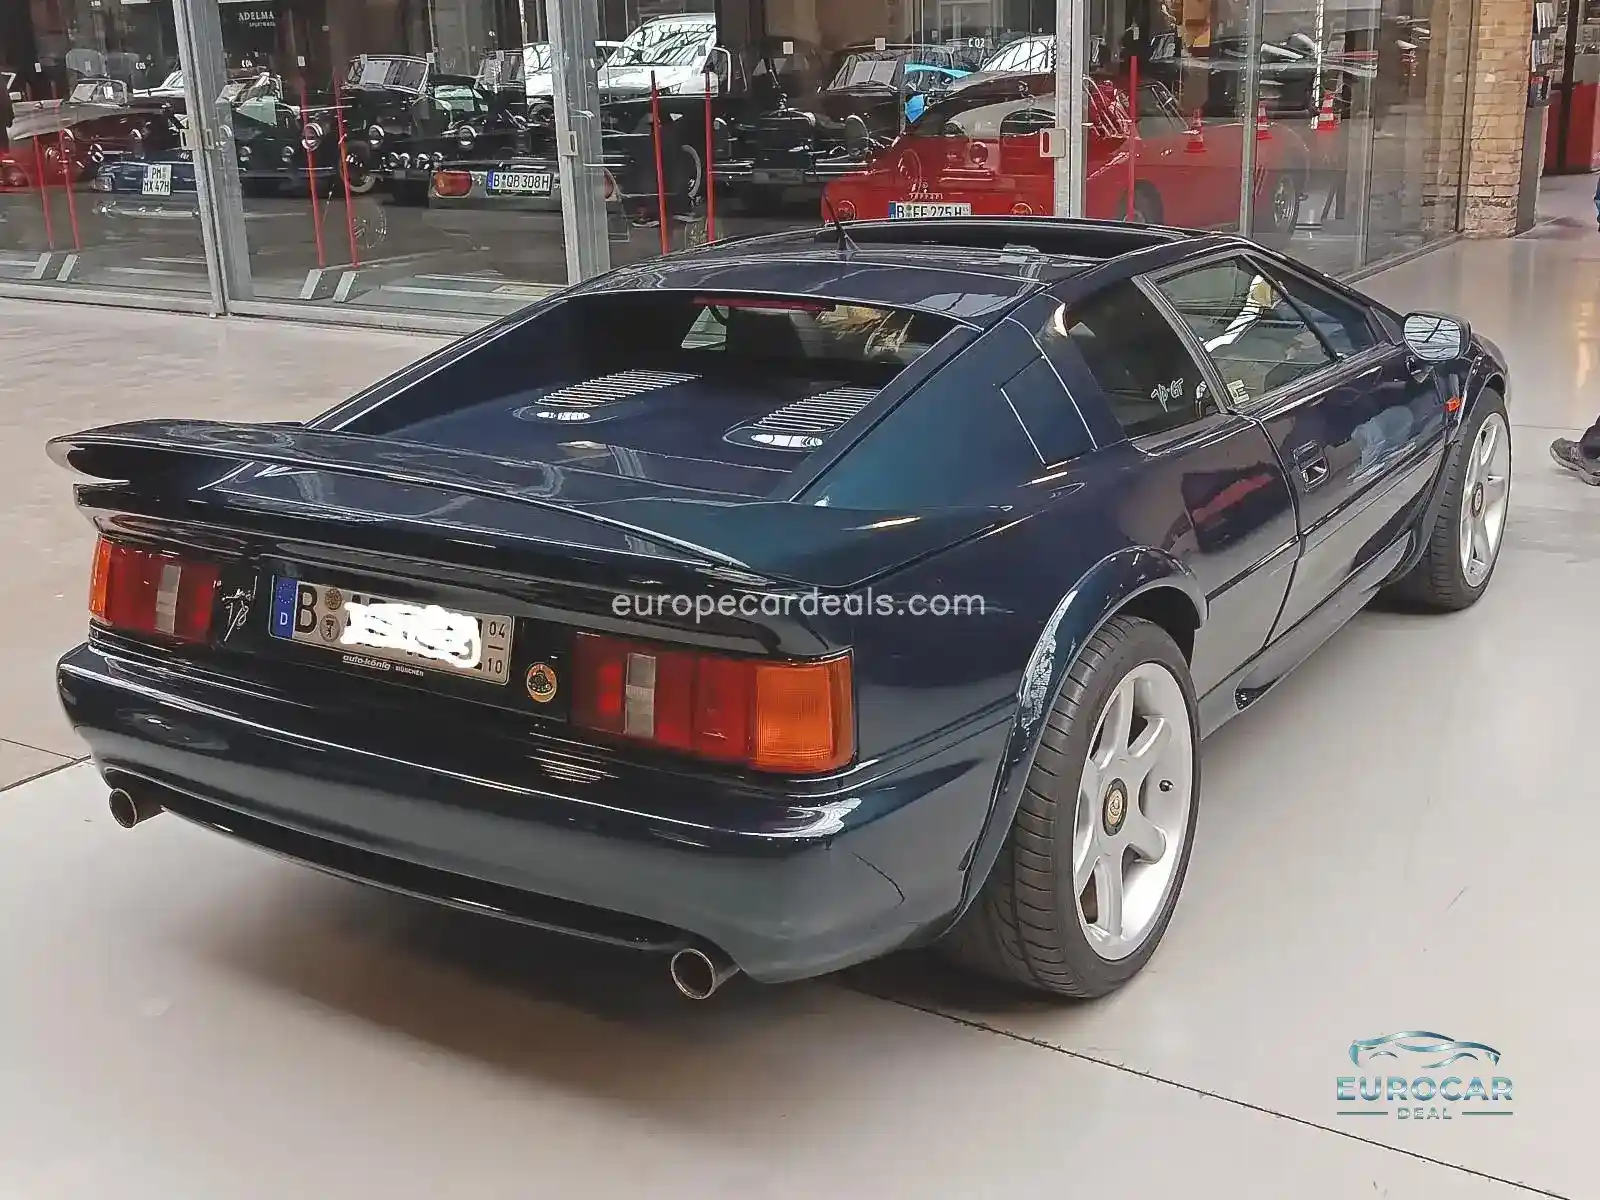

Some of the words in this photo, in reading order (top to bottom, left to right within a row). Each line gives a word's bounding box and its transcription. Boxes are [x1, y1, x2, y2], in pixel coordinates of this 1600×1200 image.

[238, 11, 275, 21] ADELMA
[489, 621, 506, 639] 04
[488, 657, 503, 674] 10
